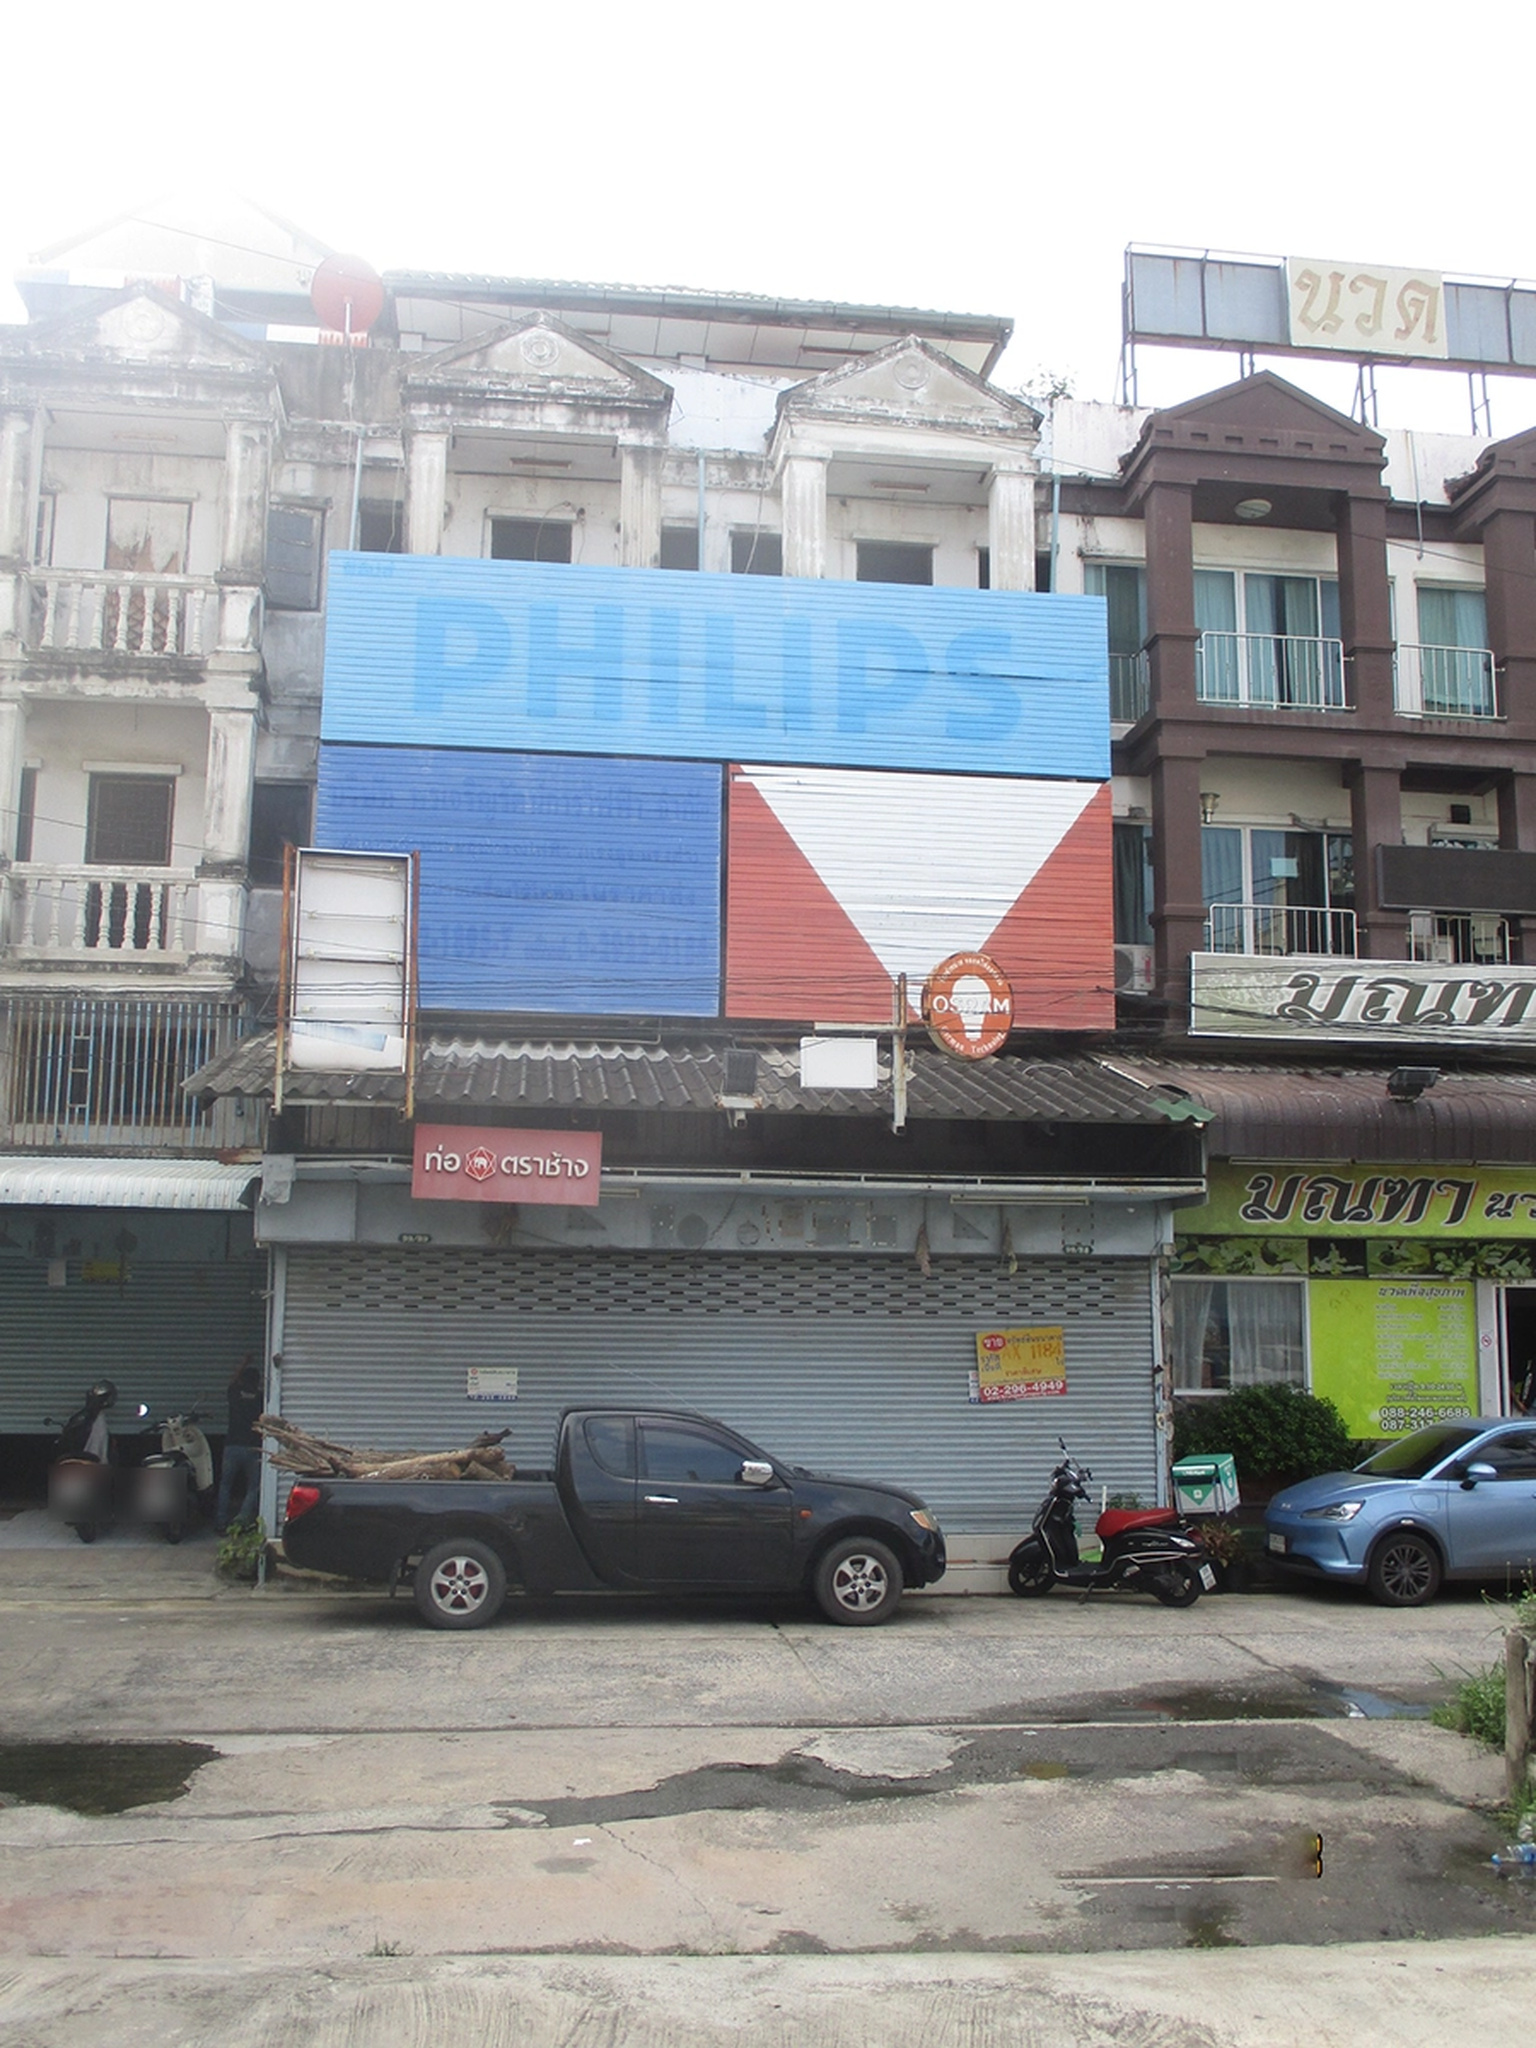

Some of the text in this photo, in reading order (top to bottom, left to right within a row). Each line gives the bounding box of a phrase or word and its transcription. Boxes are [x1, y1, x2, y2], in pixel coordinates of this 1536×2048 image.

[1293, 268, 1442, 344] นวด
[413, 597, 1026, 742] PHILIPS
[932, 995, 1011, 1015] OSRAM
[424, 1144, 590, 1178] ท่อ ตราช้าง
[1380, 1406, 1471, 1419] 088-246-6688
